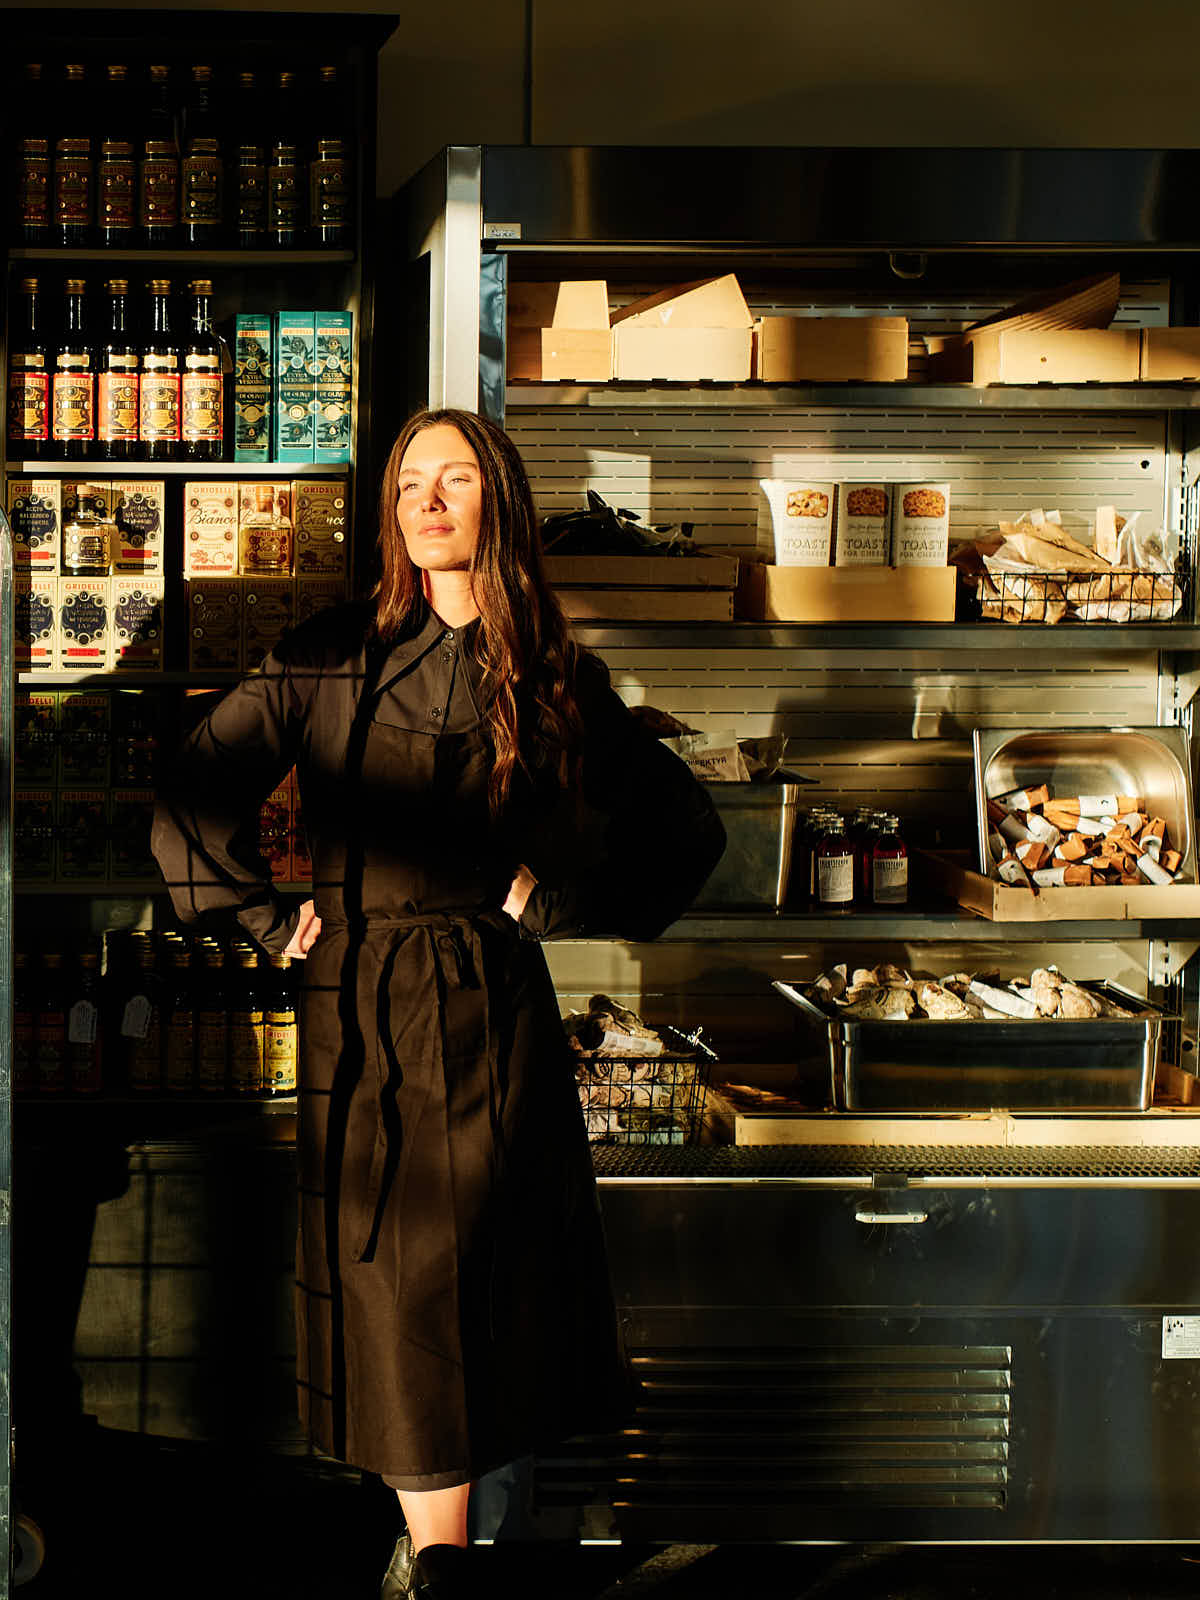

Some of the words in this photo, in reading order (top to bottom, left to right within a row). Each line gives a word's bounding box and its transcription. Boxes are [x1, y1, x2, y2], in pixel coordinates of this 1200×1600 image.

[14, 486, 54, 496] GRIDELLI
[119, 486, 158, 494] GRIDELLI
[192, 486, 232, 495] GRIDELLI
[188, 507, 238, 526] Bianco
[784, 539, 828, 550] TOAST
[846, 538, 888, 549] TOAST
[902, 539, 946, 551] TOAST
[843, 550, 858, 558] FOR
[899, 551, 914, 559] FOR
[64, 583, 104, 591] GRIDELLI
[118, 582, 158, 590] GRIDELLI
